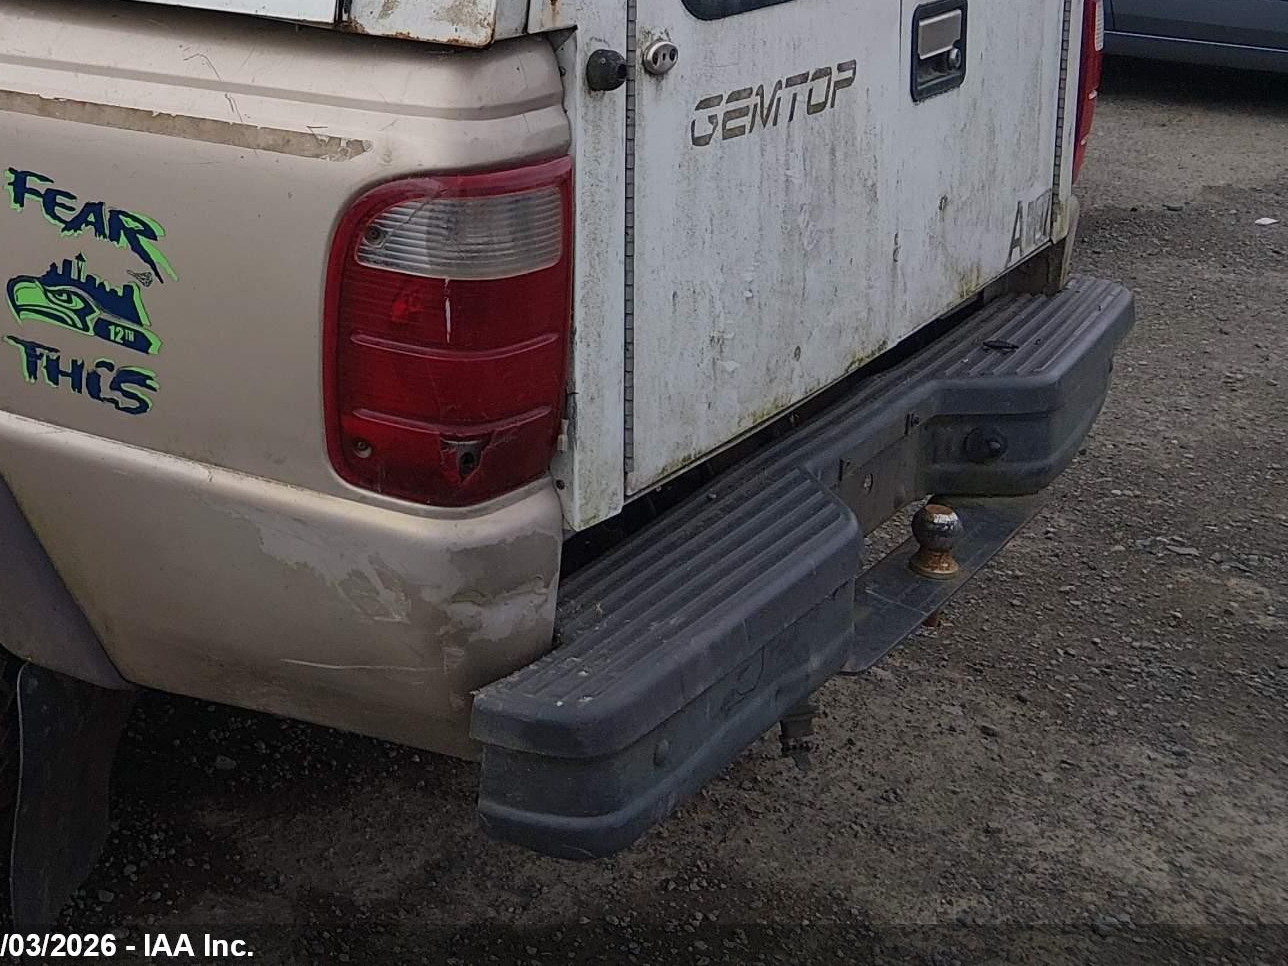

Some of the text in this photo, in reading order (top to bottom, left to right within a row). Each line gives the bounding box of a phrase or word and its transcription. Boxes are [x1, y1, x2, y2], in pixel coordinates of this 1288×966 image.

[690, 59, 857, 147] GEMTOP
[3, 167, 179, 284] FEAR
[108, 324, 135, 343] 12TH
